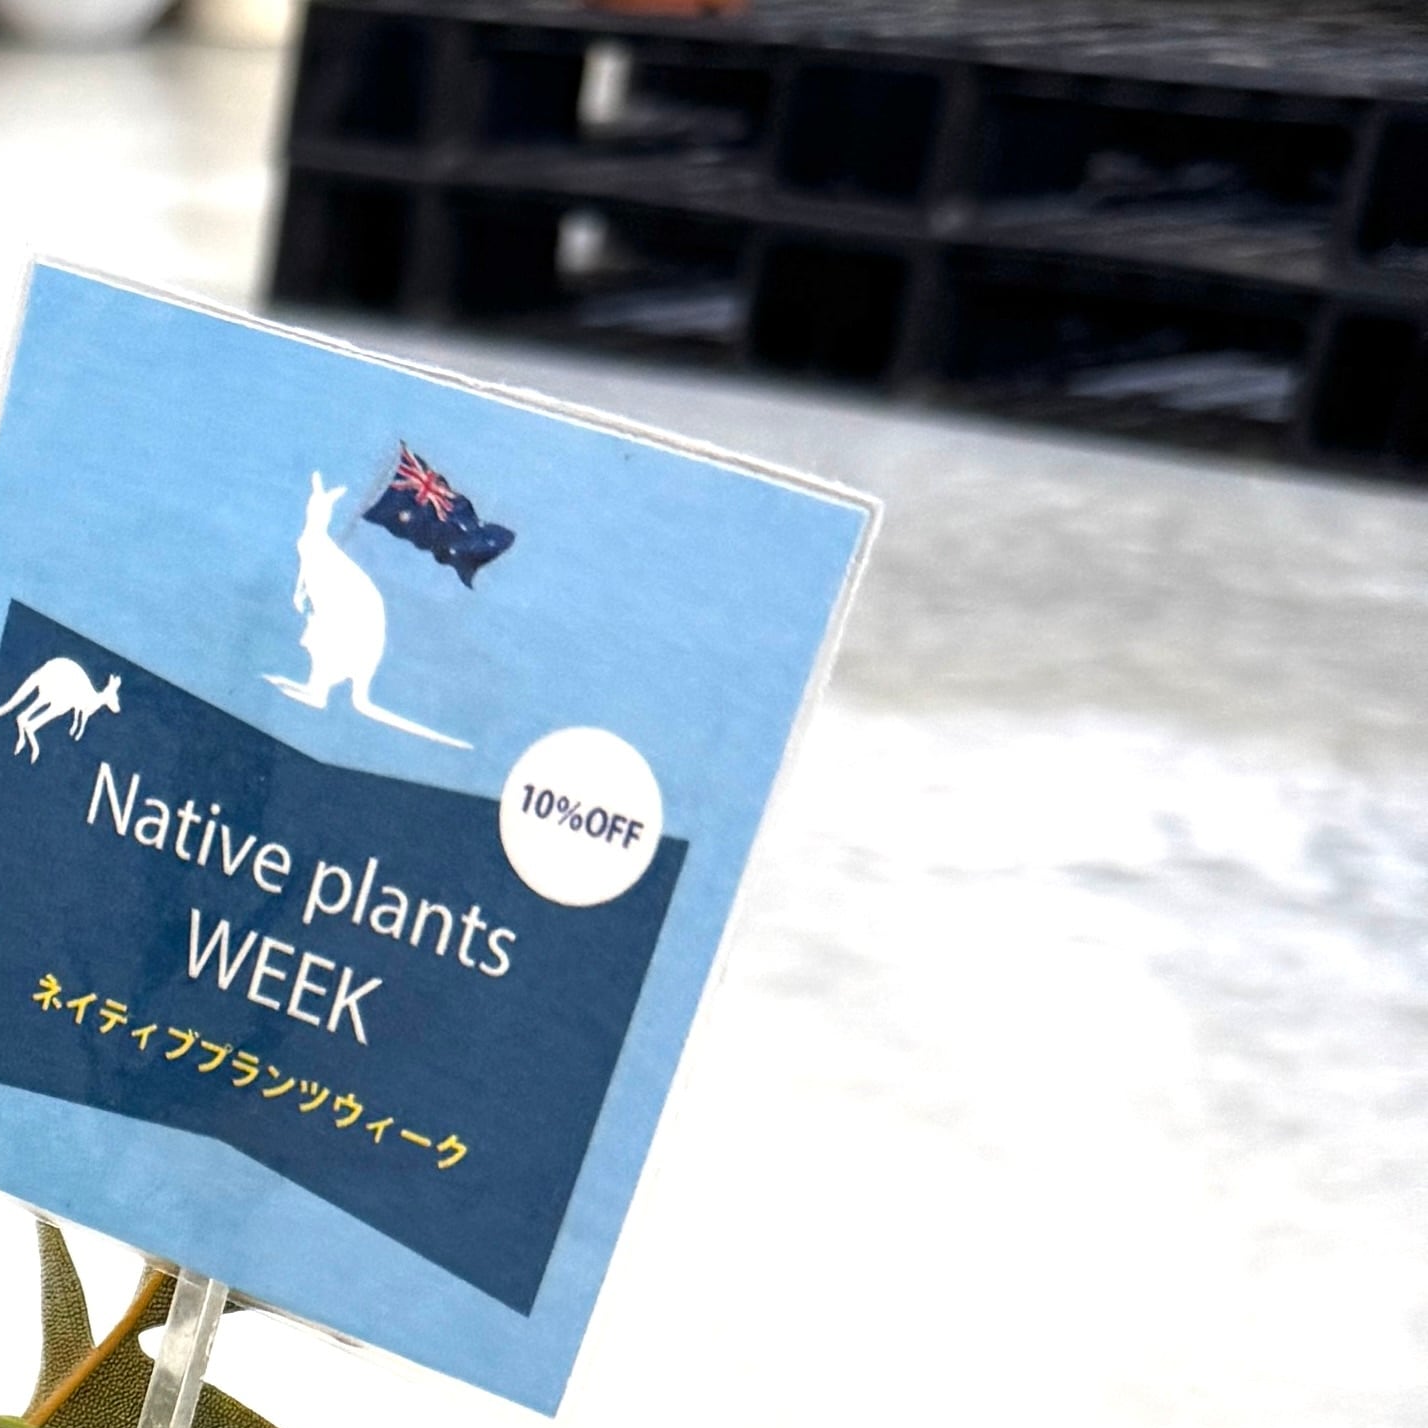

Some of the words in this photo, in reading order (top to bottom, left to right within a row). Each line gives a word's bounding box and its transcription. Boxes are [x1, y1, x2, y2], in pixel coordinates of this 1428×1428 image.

[86, 761, 293, 894] Native
[301, 856, 517, 978] plants
[522, 783, 644, 849] 10%OFF
[187, 908, 383, 1046] WEEK
[32, 973, 468, 1169] ネイティブプランツウィーク
